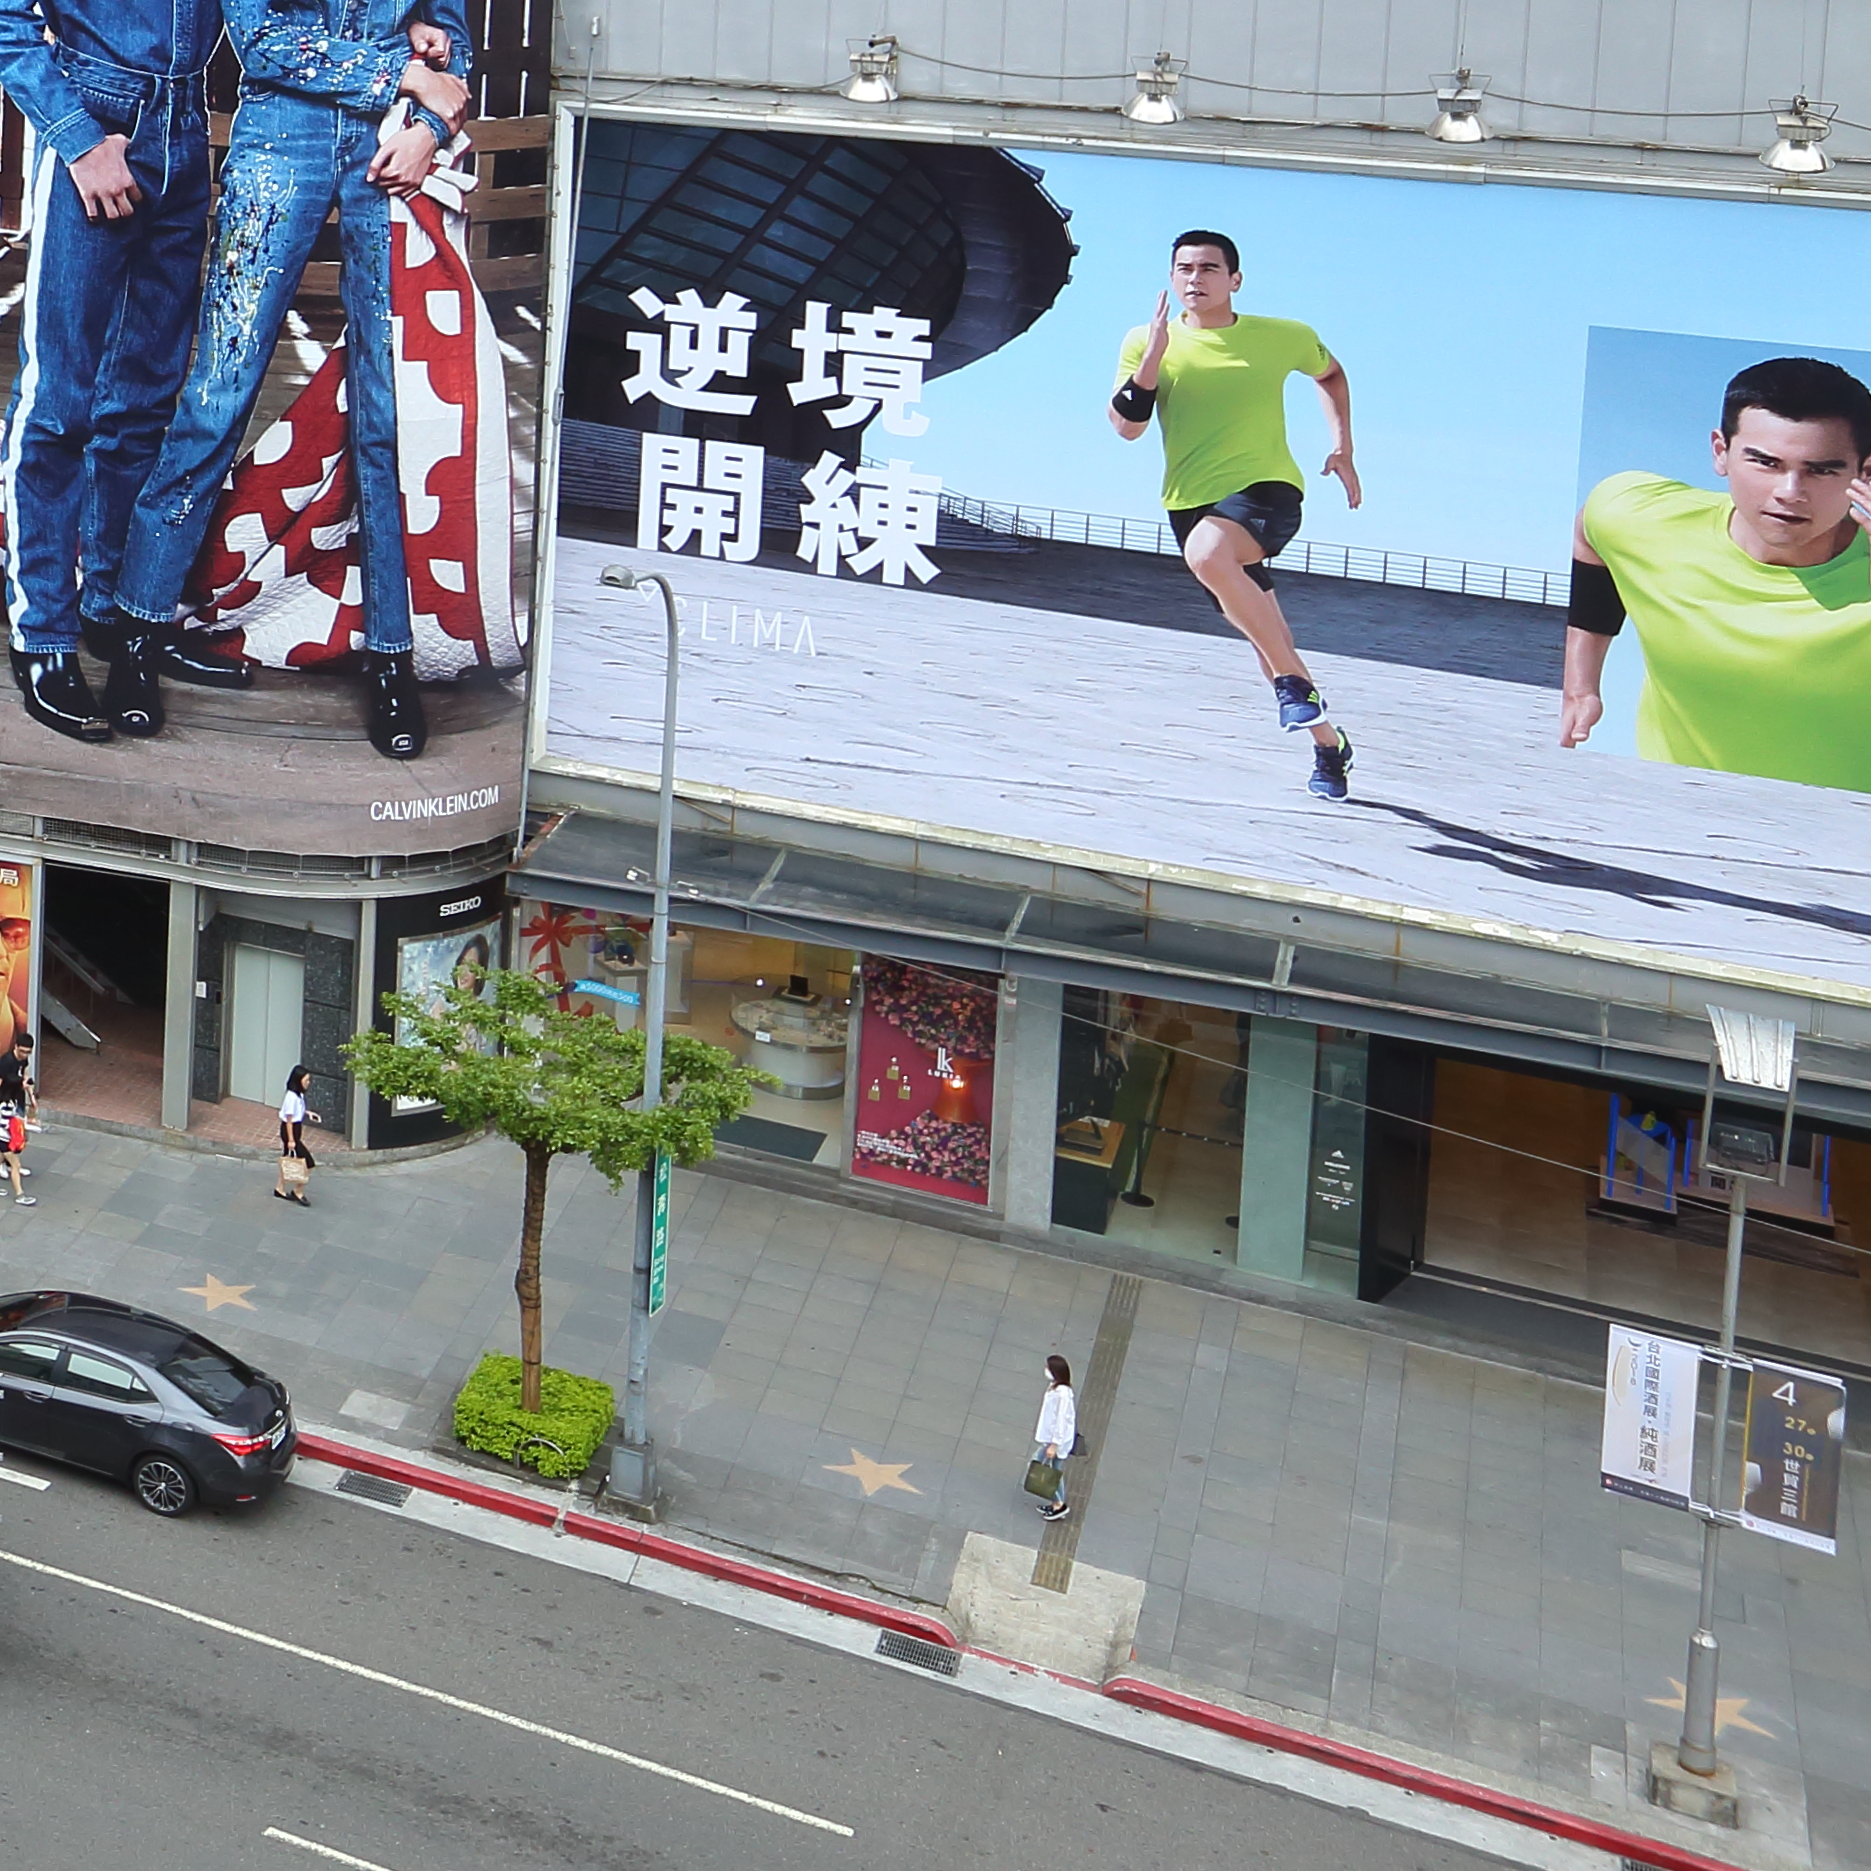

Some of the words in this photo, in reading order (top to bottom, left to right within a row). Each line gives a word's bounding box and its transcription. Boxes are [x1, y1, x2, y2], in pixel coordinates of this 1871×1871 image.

[621, 284, 934, 438] 逆境
[636, 432, 945, 585] 開練
[370, 784, 499, 821] CALVINKLEIN.COM
[439, 896, 481, 917] SEIKO
[1772, 1381, 1796, 1407] 4
[1785, 1416, 1807, 1430] 27
[1783, 1442, 1805, 1458] 30
